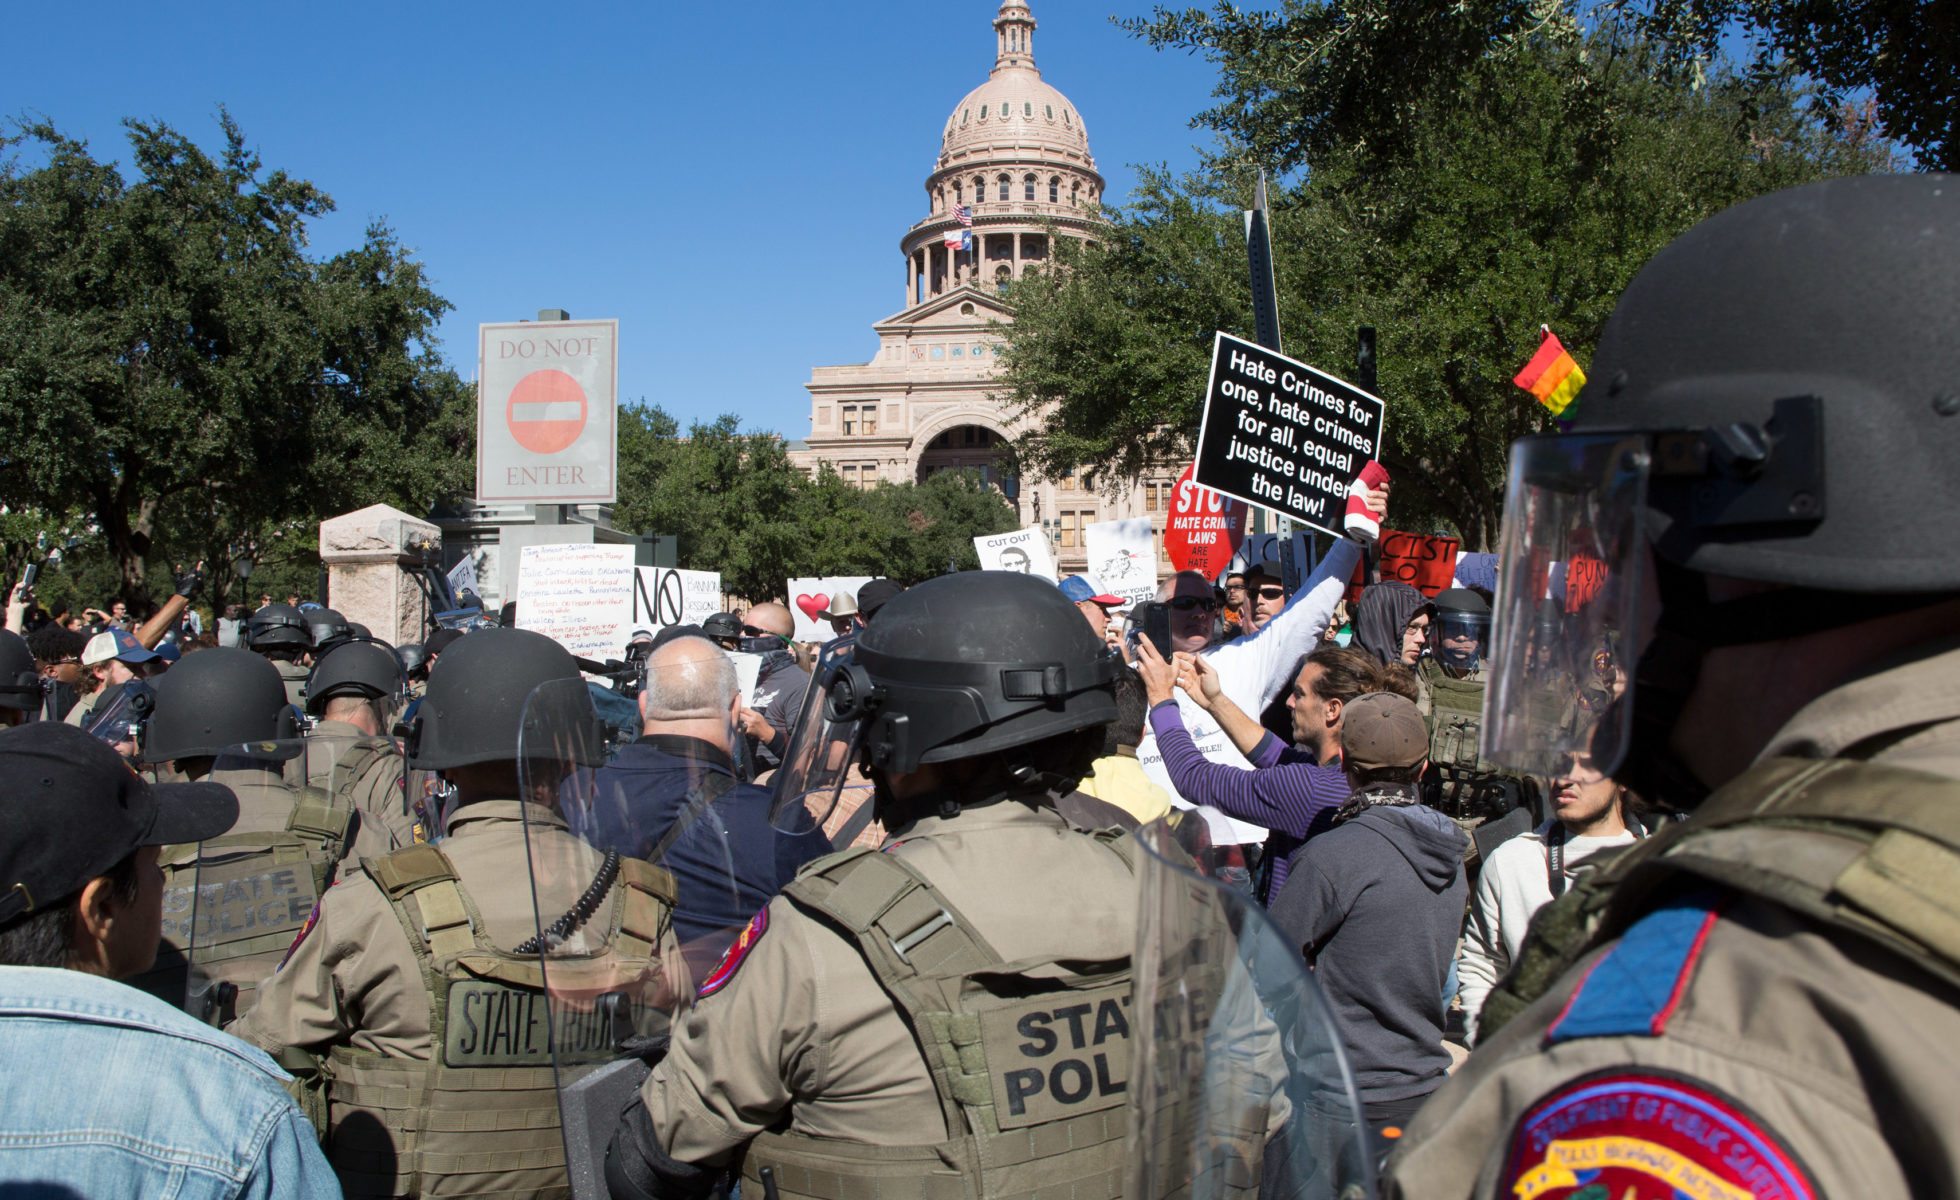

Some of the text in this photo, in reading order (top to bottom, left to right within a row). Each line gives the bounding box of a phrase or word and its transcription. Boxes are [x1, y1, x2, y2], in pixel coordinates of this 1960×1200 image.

[500, 337, 598, 359] DO NOT
[1230, 350, 1373, 426] Hate Crimes for
[1221, 380, 1372, 455] one, hate crimes
[1238, 410, 1353, 473] for all, equal
[507, 466, 586, 486] ENTER
[1226, 436, 1351, 500] justice under
[1252, 473, 1325, 518] the law!
[1174, 516, 1236, 529] HATE CRIME
[987, 533, 1031, 548] CUT OUT
[1188, 531, 1217, 544] LAWS
[1191, 546, 1208, 556] ARE
[1188, 558, 1208, 568] HATE
[633, 567, 683, 627] NO
[1122, 593, 1154, 606] DER
[1129, 586, 1152, 594] YOUR
[162, 869, 298, 913] STATE
[460, 990, 538, 1055] STATE
[1633, 1096, 1660, 1121] OF
